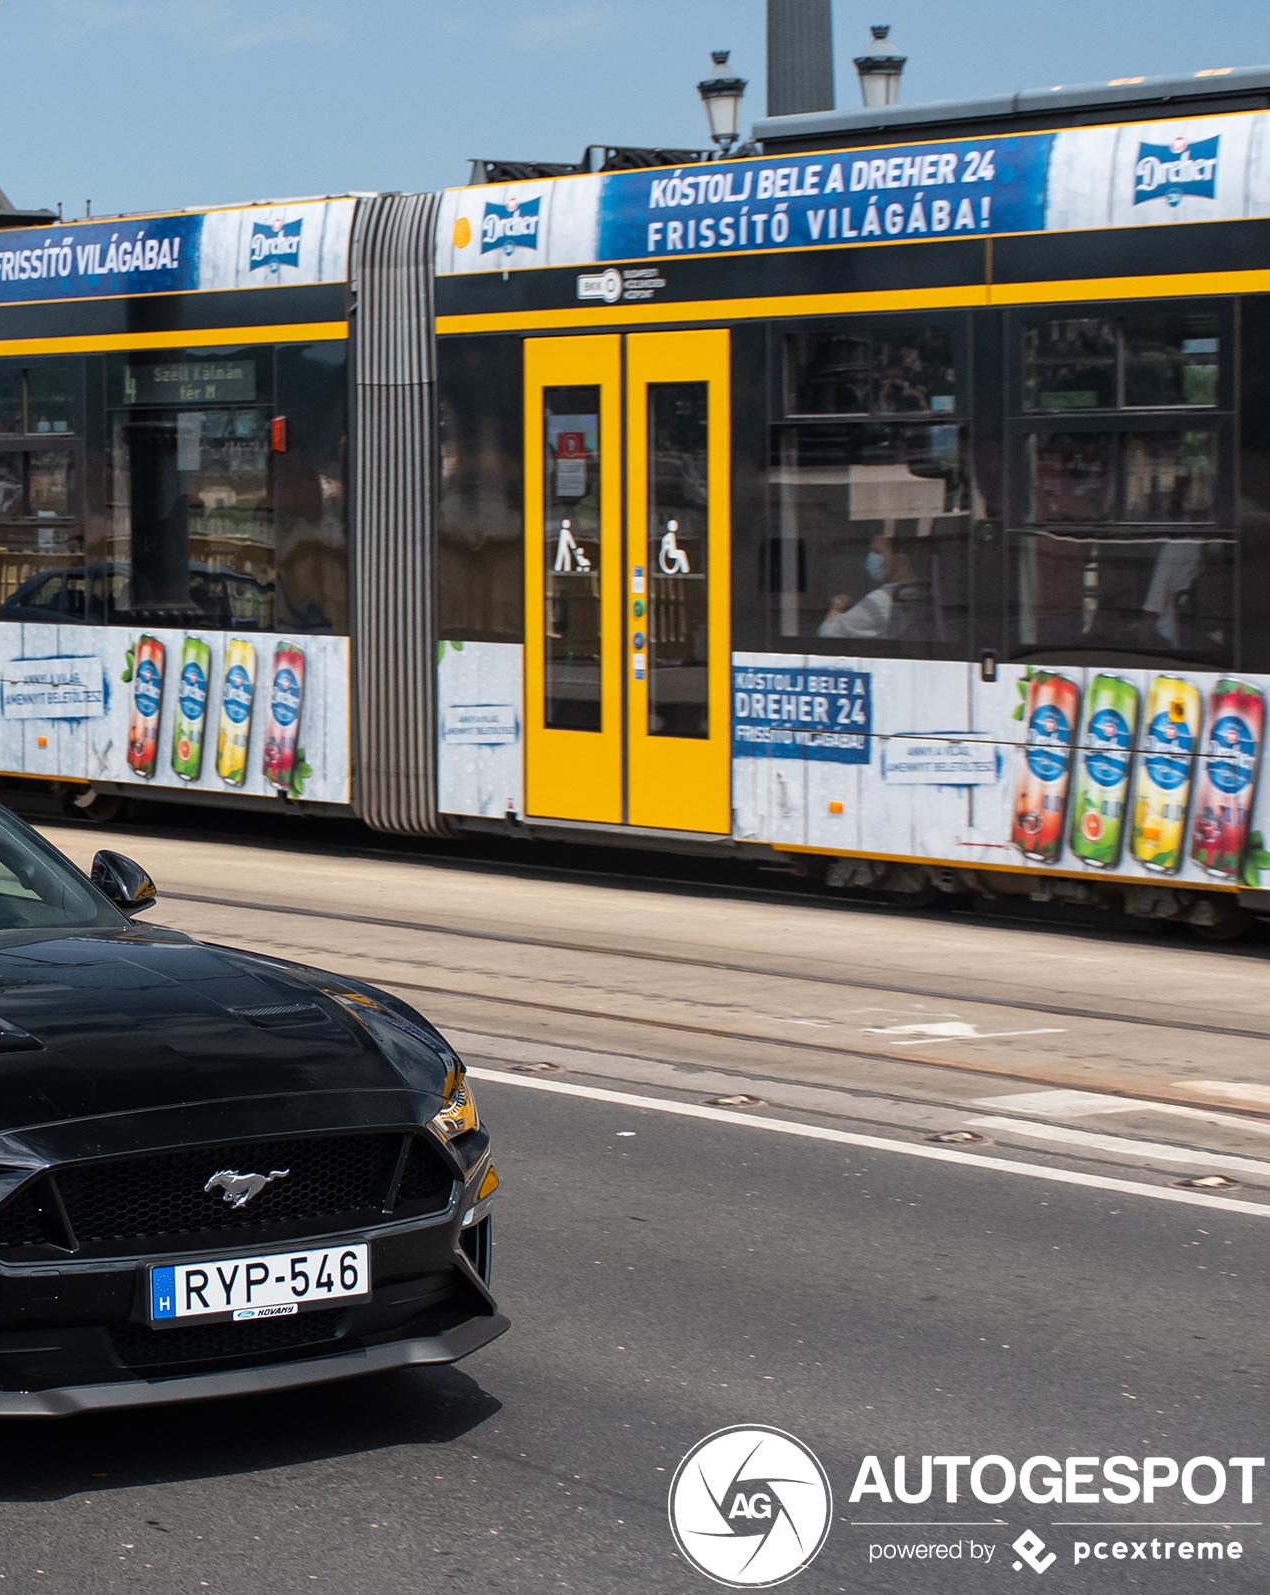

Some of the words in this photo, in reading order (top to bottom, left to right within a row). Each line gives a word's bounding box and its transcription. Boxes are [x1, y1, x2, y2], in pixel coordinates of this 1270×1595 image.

[649, 169, 754, 209] KÓSTOLJ
[756, 164, 823, 200] BELE
[824, 163, 845, 195] A
[849, 152, 958, 192] DREHER
[961, 149, 996, 183] 24
[1135, 150, 1217, 191] Dreher
[482, 209, 539, 243] Dreher
[647, 202, 790, 252] FRISSÍTŐ
[806, 191, 991, 240] VILÁGÁBA!
[76, 231, 180, 275] VILÁGÁBA!
[251, 230, 301, 261] Dreher
[735, 668, 804, 692] KÓSTOLJ
[807, 675, 849, 695] BELE
[852, 678, 865, 695] A
[735, 692, 829, 723] DREHER
[836, 697, 866, 725] 24
[185, 1250, 358, 1310] RYP-546
[159, 1296, 171, 1312] H
